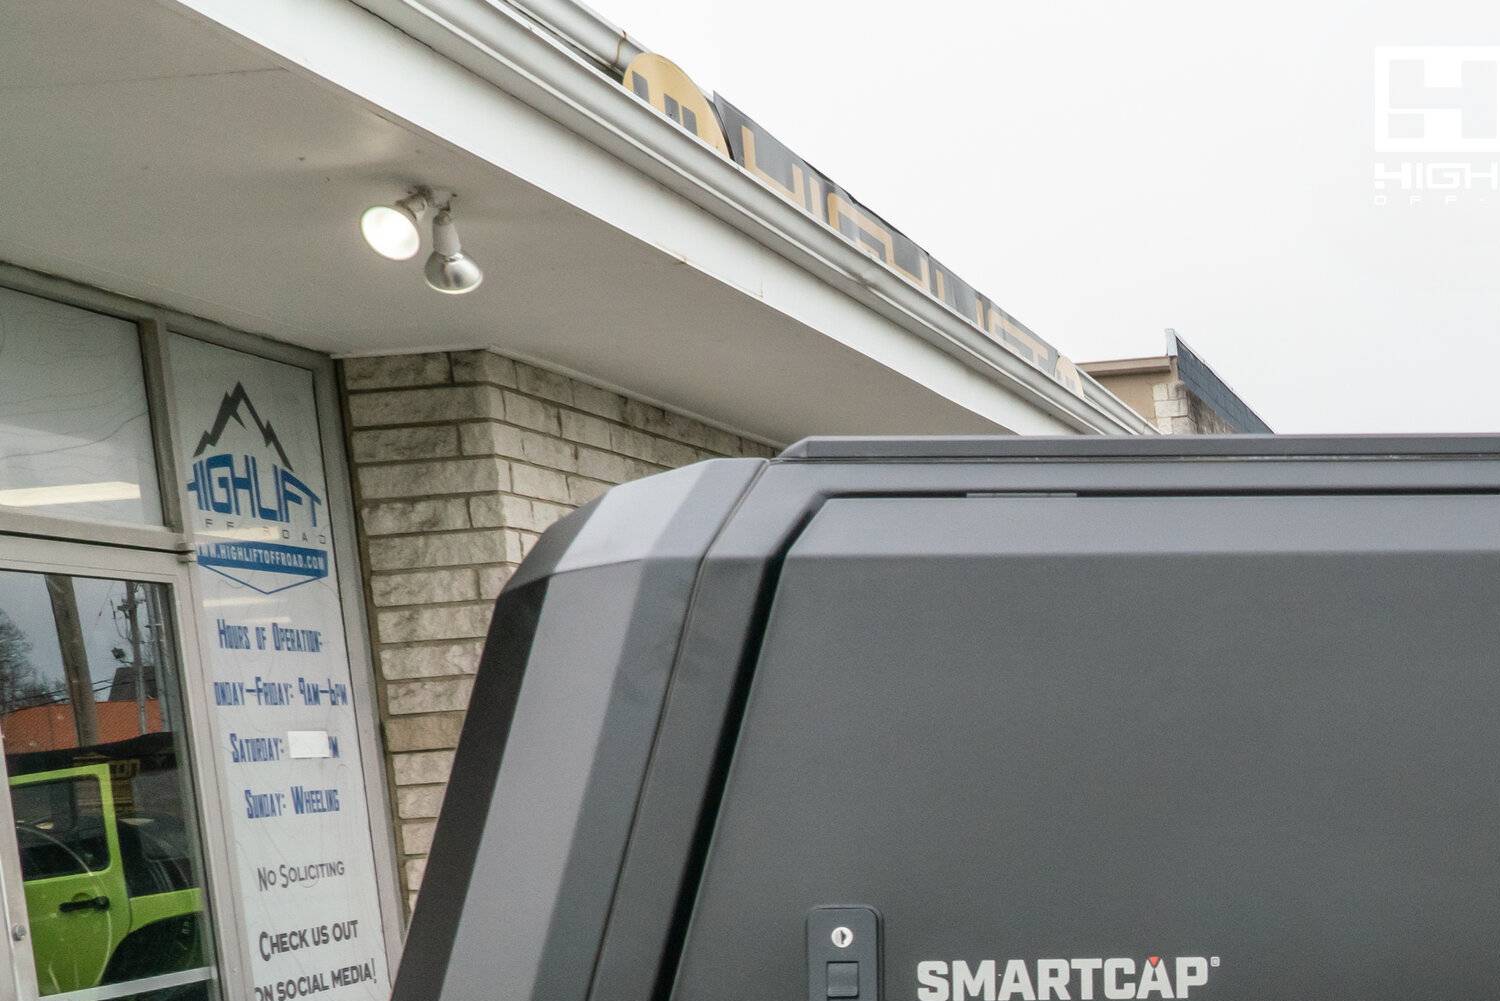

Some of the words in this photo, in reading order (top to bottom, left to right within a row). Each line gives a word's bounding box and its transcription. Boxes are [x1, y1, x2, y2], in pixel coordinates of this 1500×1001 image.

[257, 867, 277, 892] NO
[279, 861, 345, 889] SOLICITING
[259, 929, 310, 962] CHECK
[311, 925, 330, 947] US
[332, 920, 359, 942] OUT
[276, 973, 329, 1001] SOCIAL
[331, 957, 377, 988] MEDIA!
